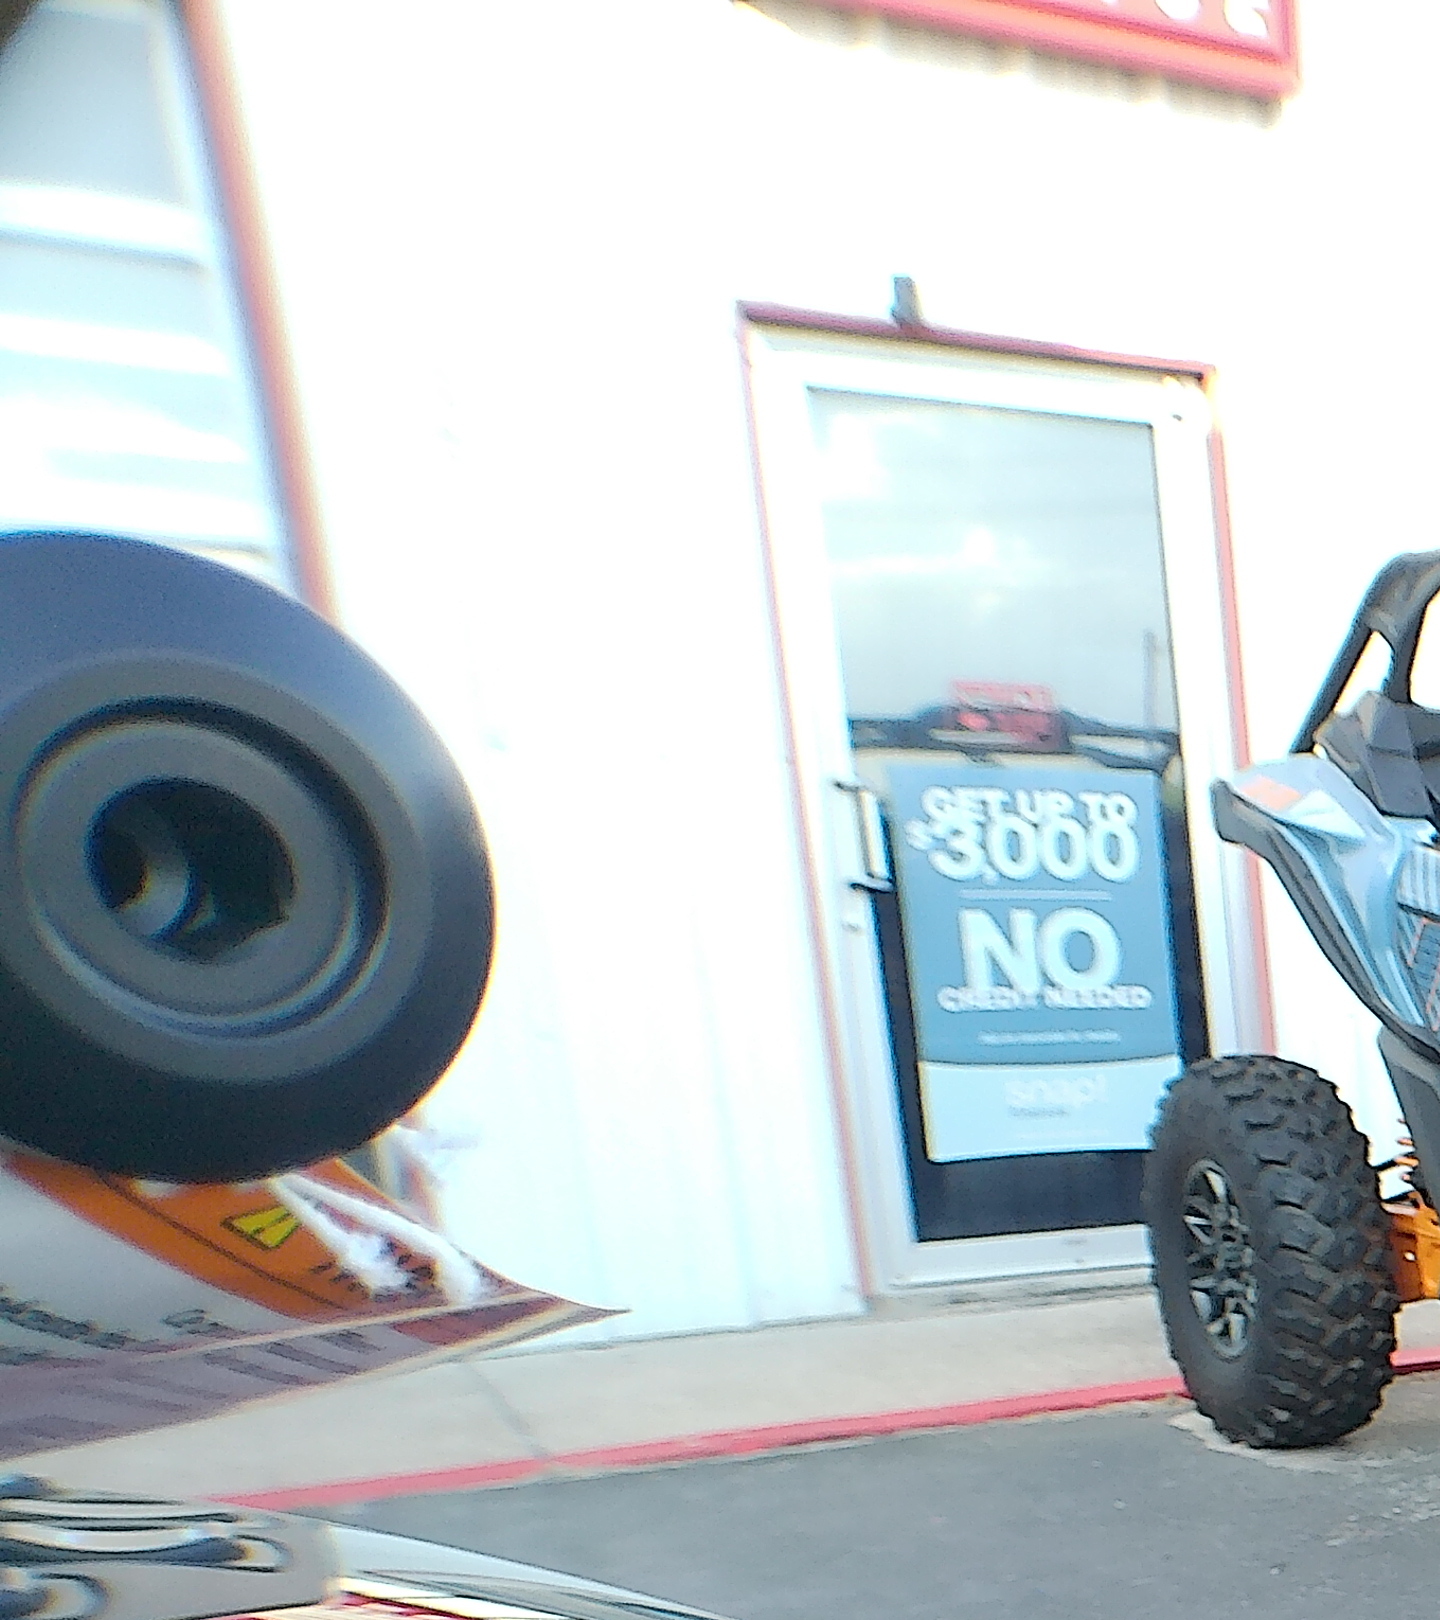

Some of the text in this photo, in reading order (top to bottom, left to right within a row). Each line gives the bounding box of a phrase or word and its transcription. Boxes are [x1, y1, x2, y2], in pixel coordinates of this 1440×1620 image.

[921, 785, 1139, 825] GET UP TO
[958, 906, 1122, 996] NO
